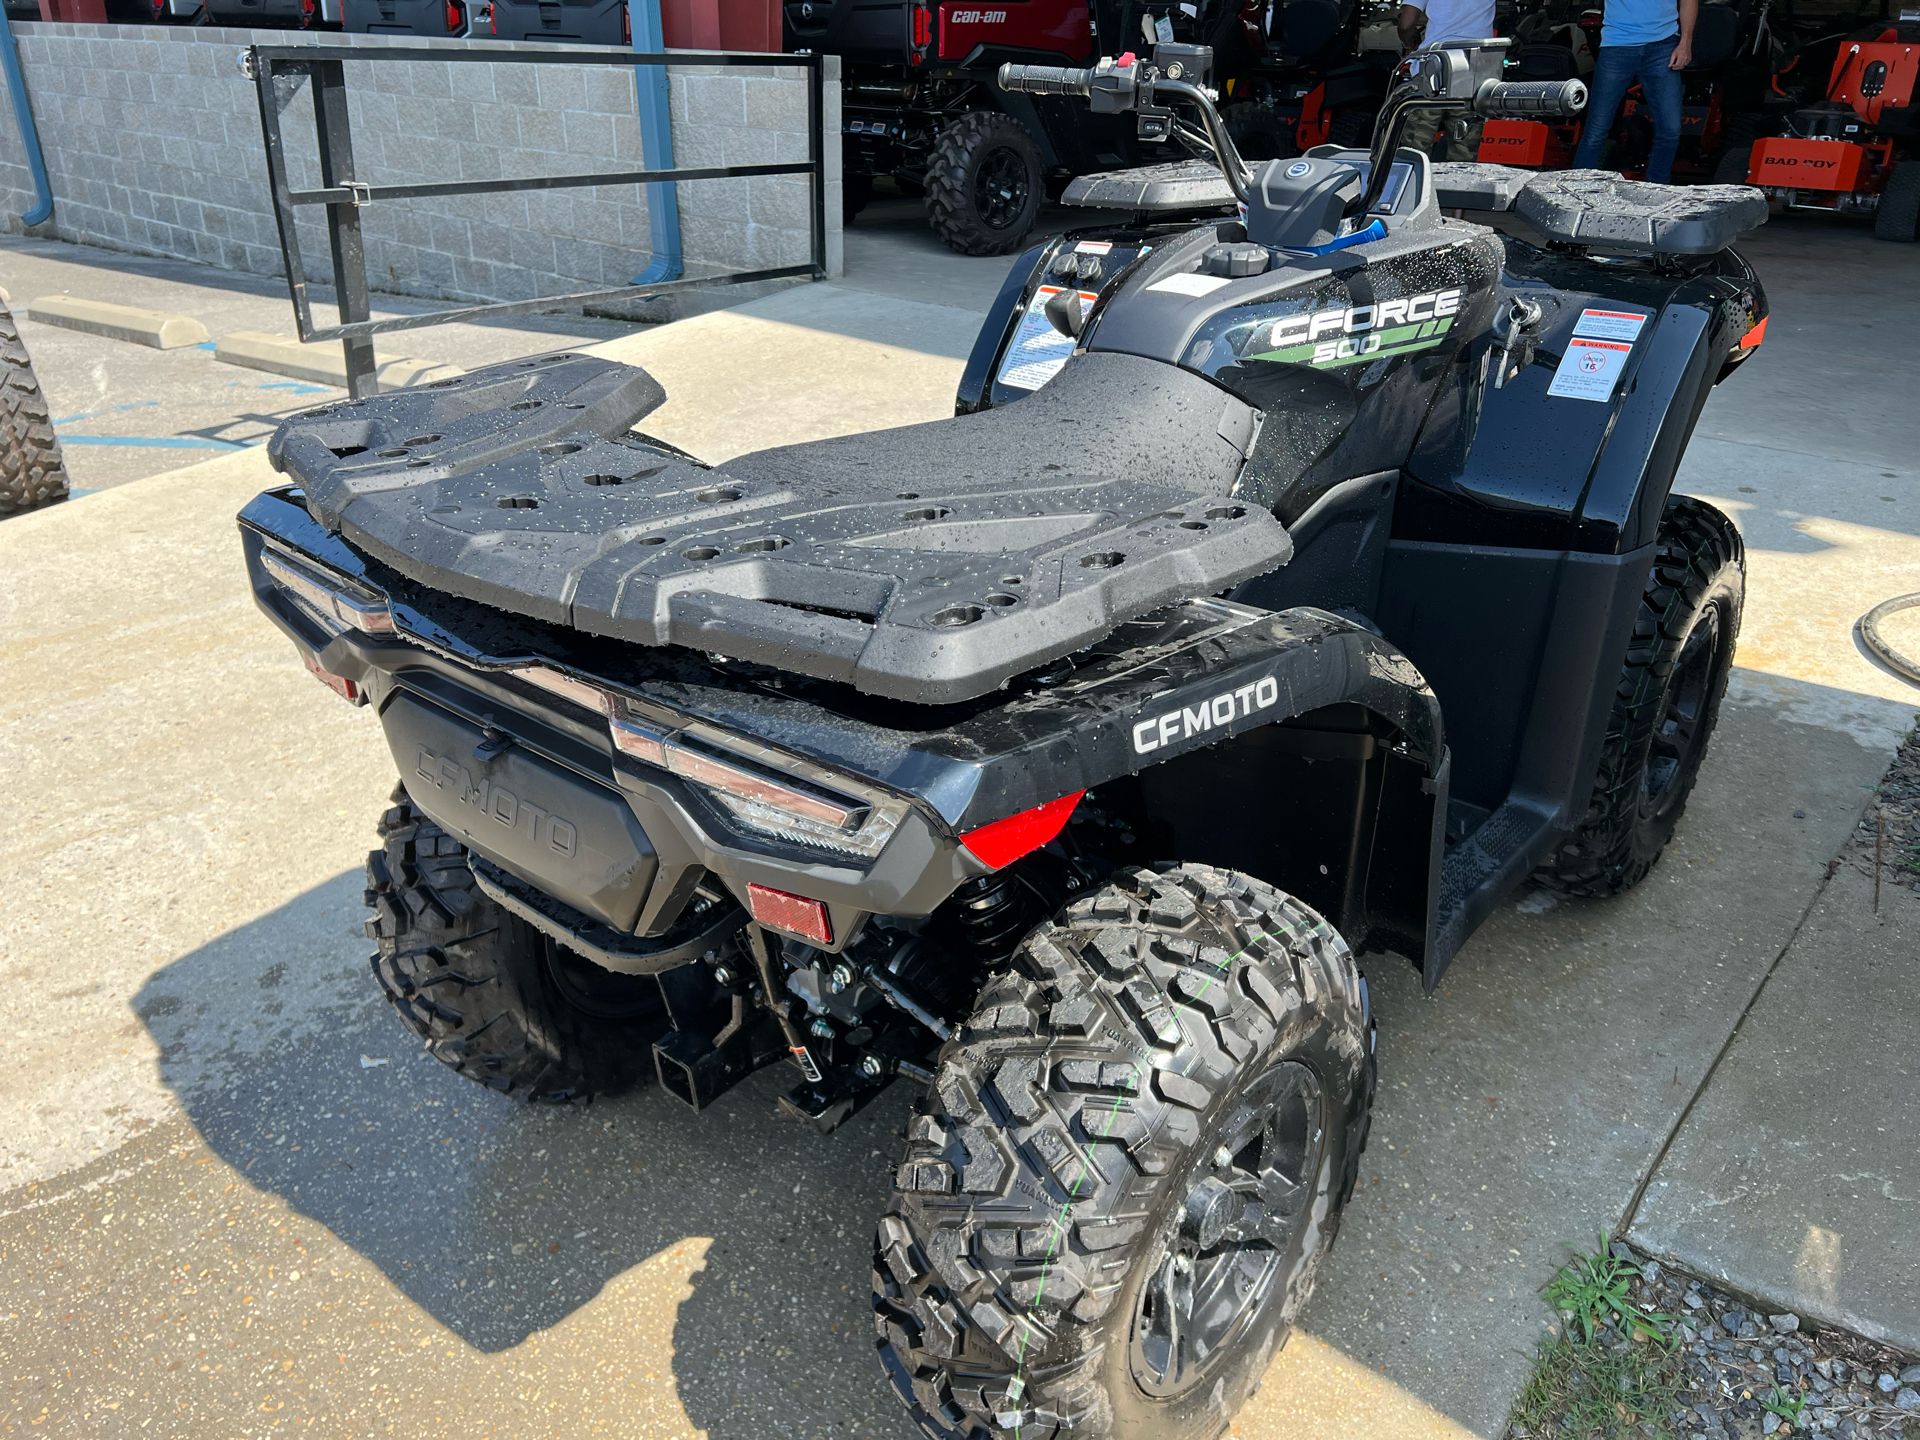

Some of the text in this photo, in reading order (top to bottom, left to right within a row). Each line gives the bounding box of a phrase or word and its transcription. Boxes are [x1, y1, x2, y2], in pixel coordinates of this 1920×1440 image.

[1764, 157, 1798, 166] BAD
[1270, 289, 1462, 347] CFORCE
[1312, 335, 1382, 364] 500
[1585, 362, 1597, 370] 16
[1133, 676, 1278, 754] CFMOTO
[416, 743, 578, 859] CFMOTO
